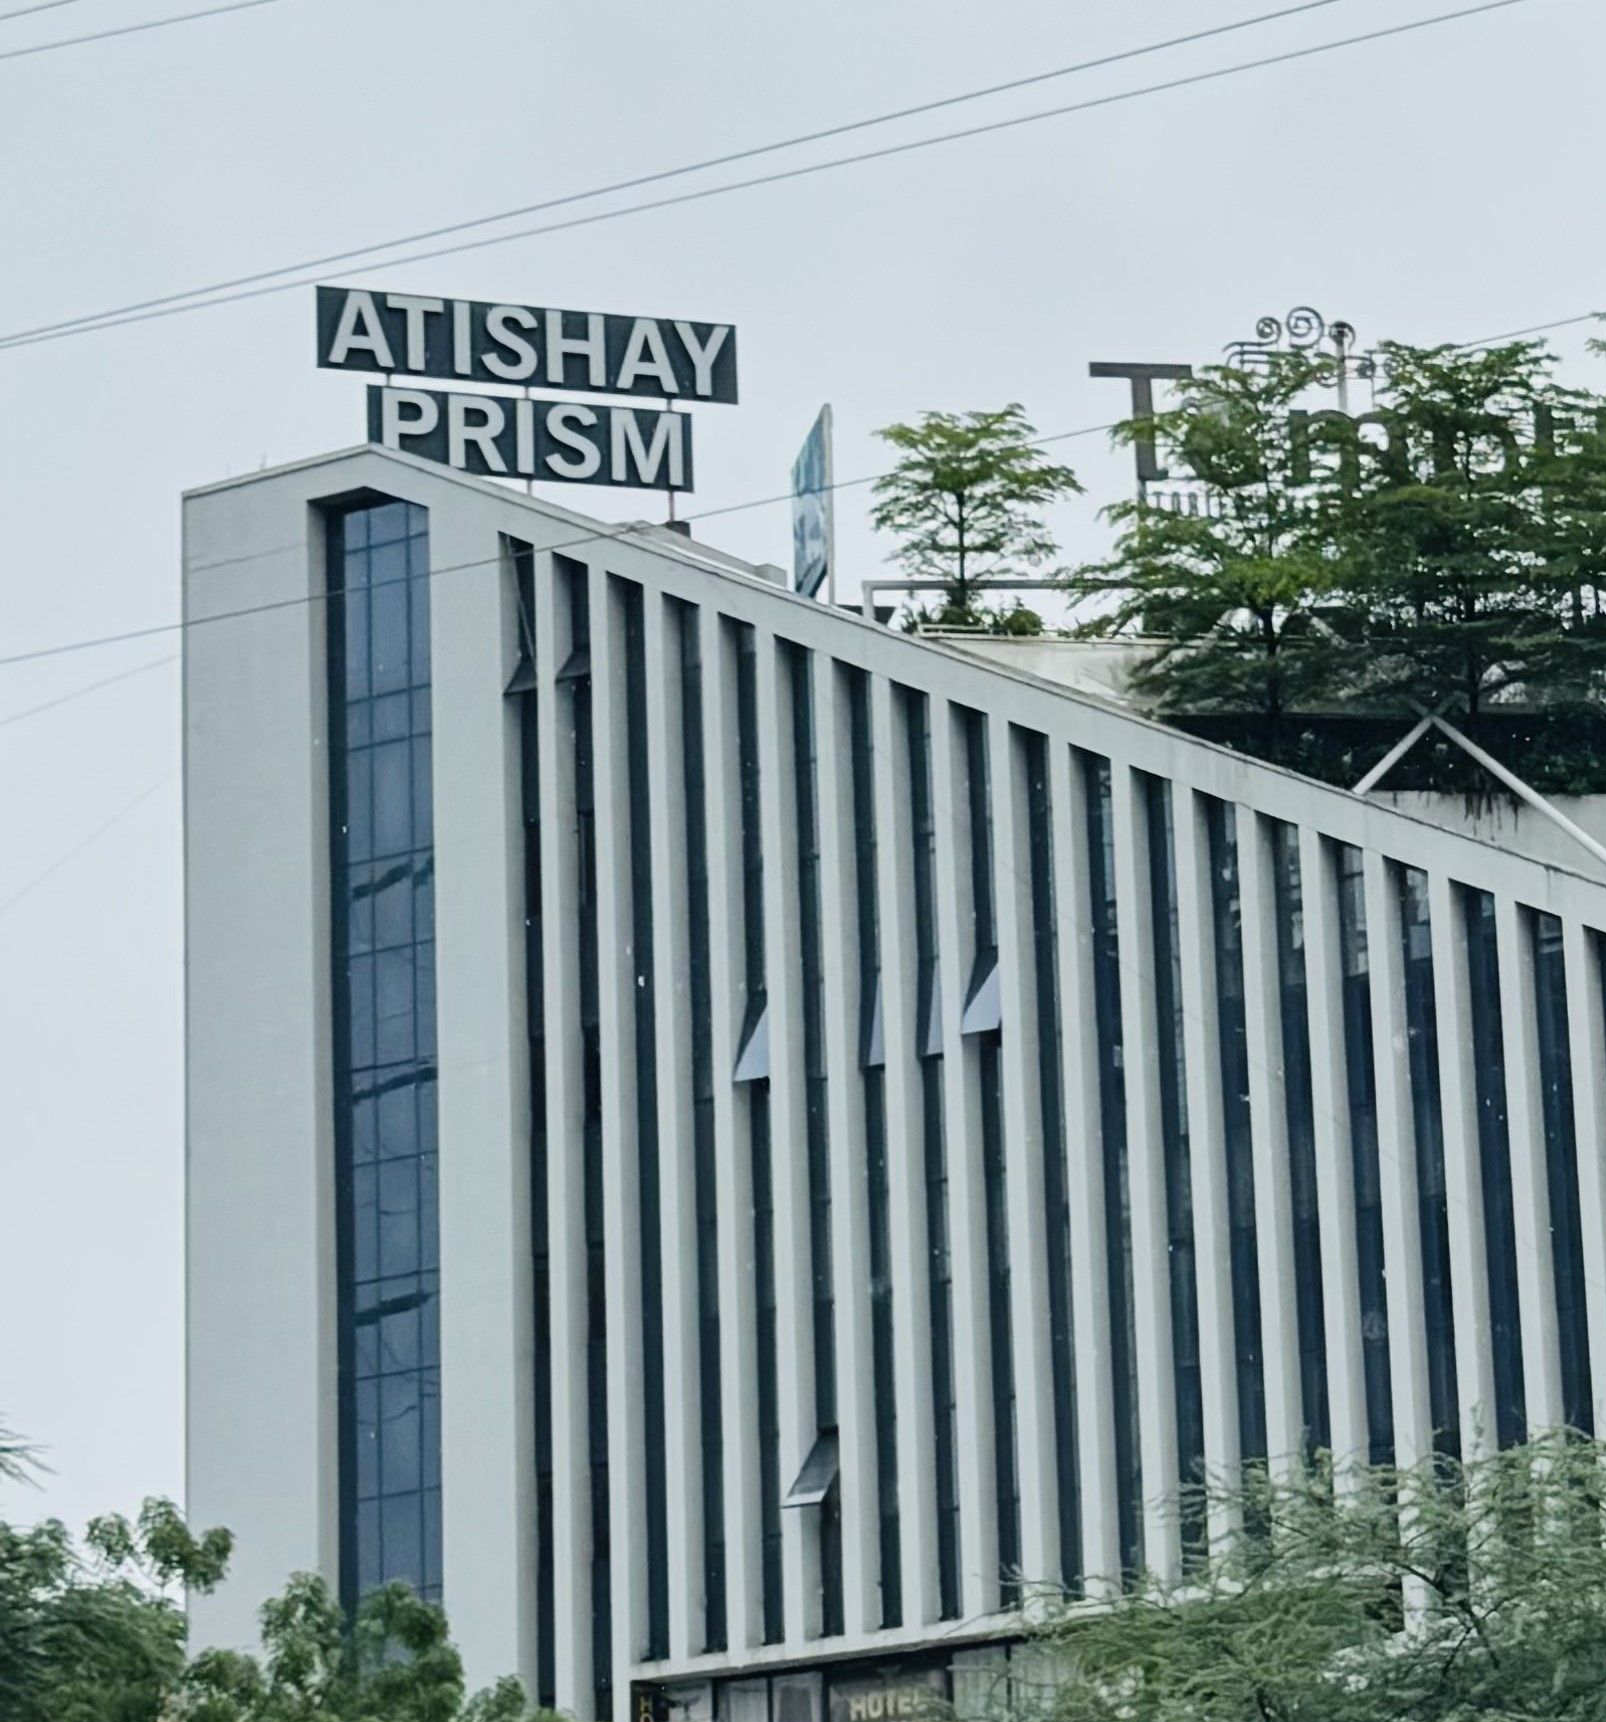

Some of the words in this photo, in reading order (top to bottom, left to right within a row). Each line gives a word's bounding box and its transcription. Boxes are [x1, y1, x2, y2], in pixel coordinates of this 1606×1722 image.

[328, 289, 730, 397] ATISHAY
[382, 387, 684, 486] PRISM
[849, 1688, 929, 1721] HOTEL
